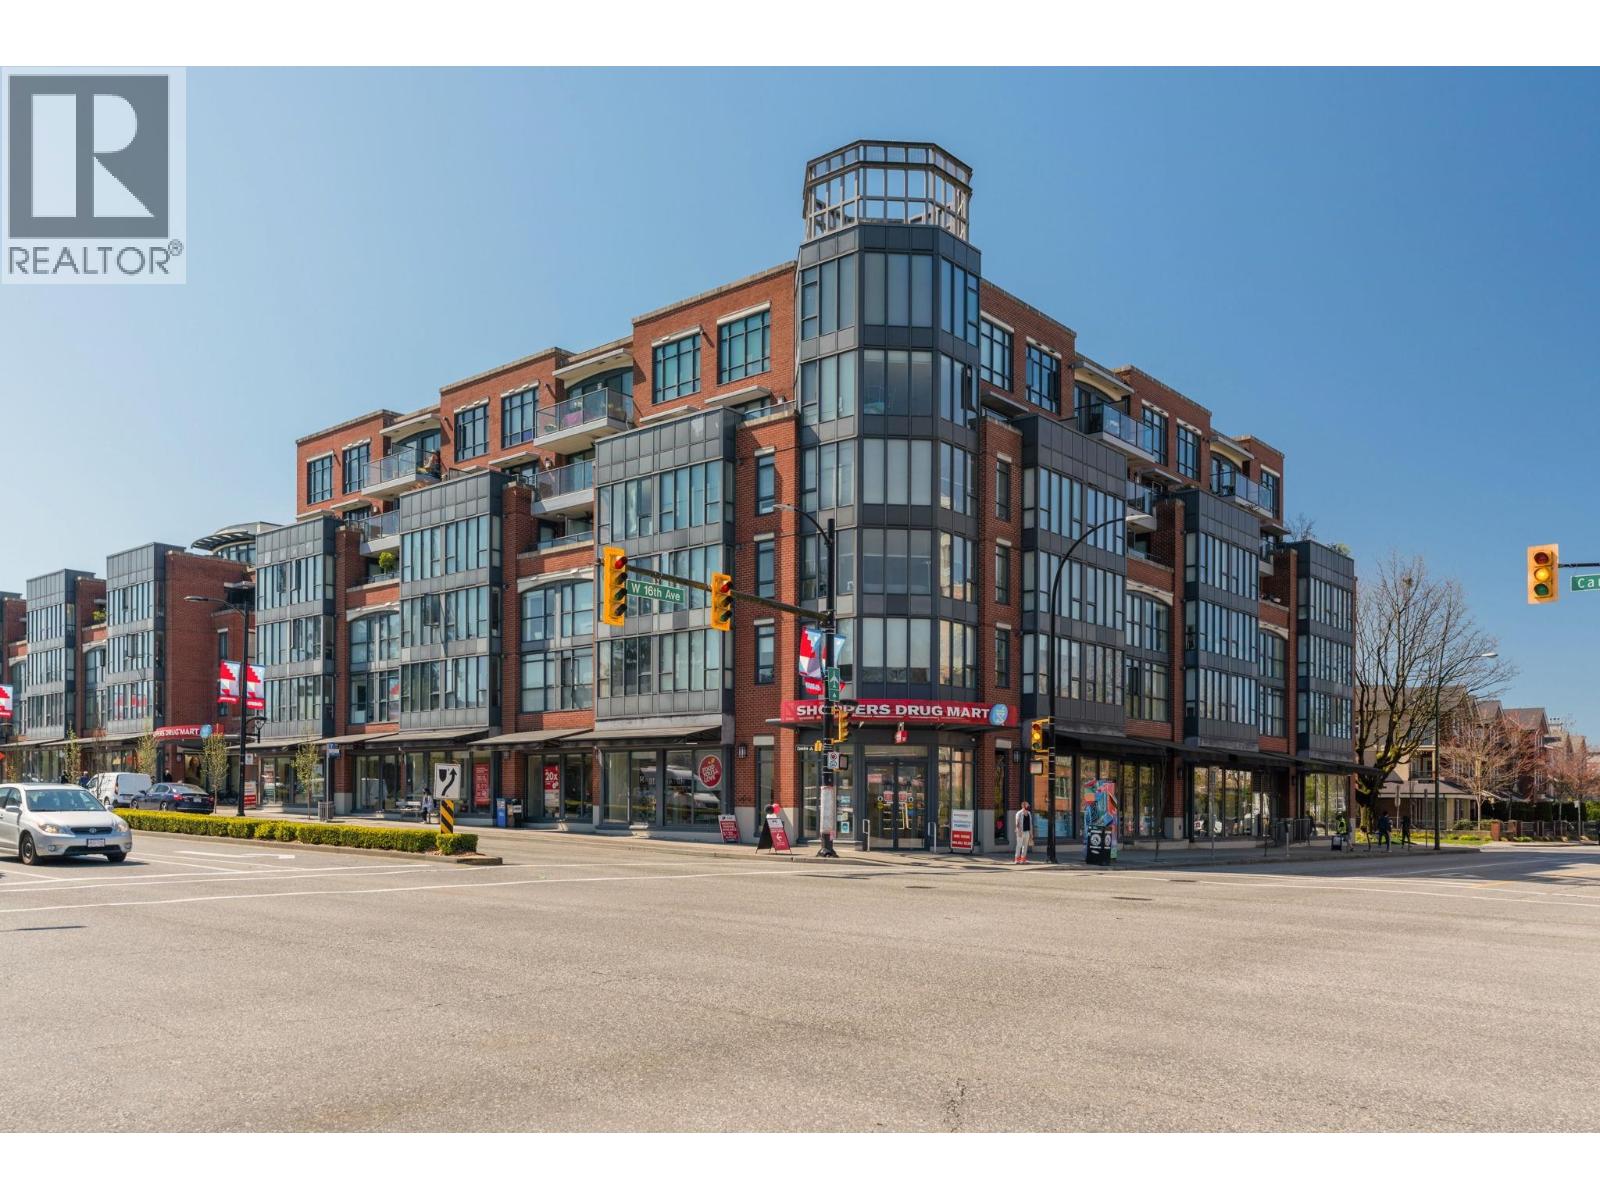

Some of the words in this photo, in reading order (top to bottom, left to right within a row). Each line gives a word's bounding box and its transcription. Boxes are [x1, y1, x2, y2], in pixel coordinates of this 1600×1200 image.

[1577, 576, 1600, 589] Ca
[631, 582, 641, 594] W
[644, 585, 662, 598] 16th
[665, 589, 681, 601] Ave
[895, 704, 943, 716] DRUG
[946, 706, 990, 718] MART
[180, 727, 200, 736] MART
